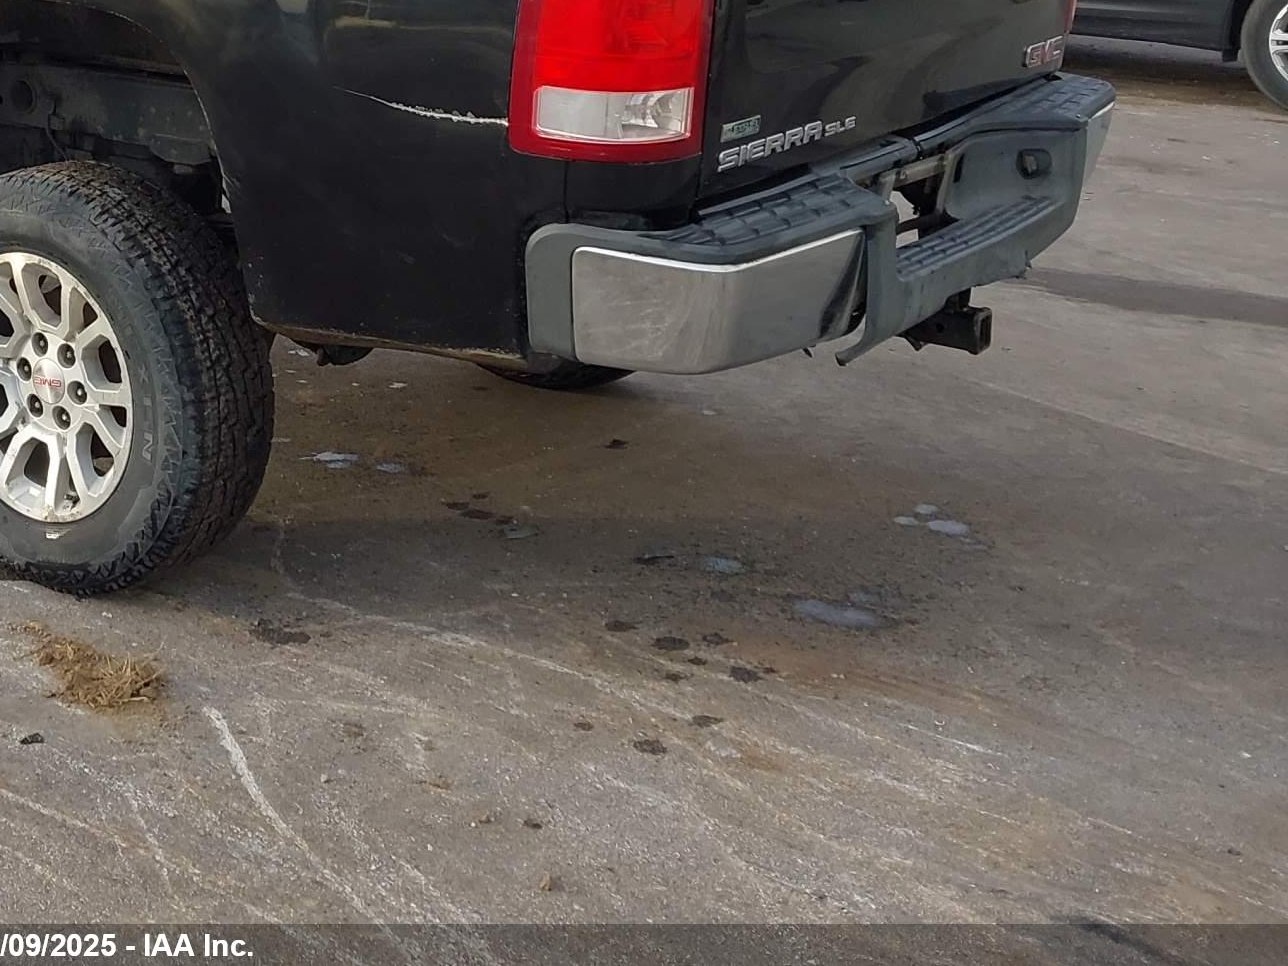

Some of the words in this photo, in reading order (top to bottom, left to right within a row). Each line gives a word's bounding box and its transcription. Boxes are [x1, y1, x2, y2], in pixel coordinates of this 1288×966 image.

[1025, 35, 1064, 68] GMC
[717, 120, 823, 172] SIERRA
[824, 115, 857, 137] SLE
[33, 375, 62, 388] GMC
